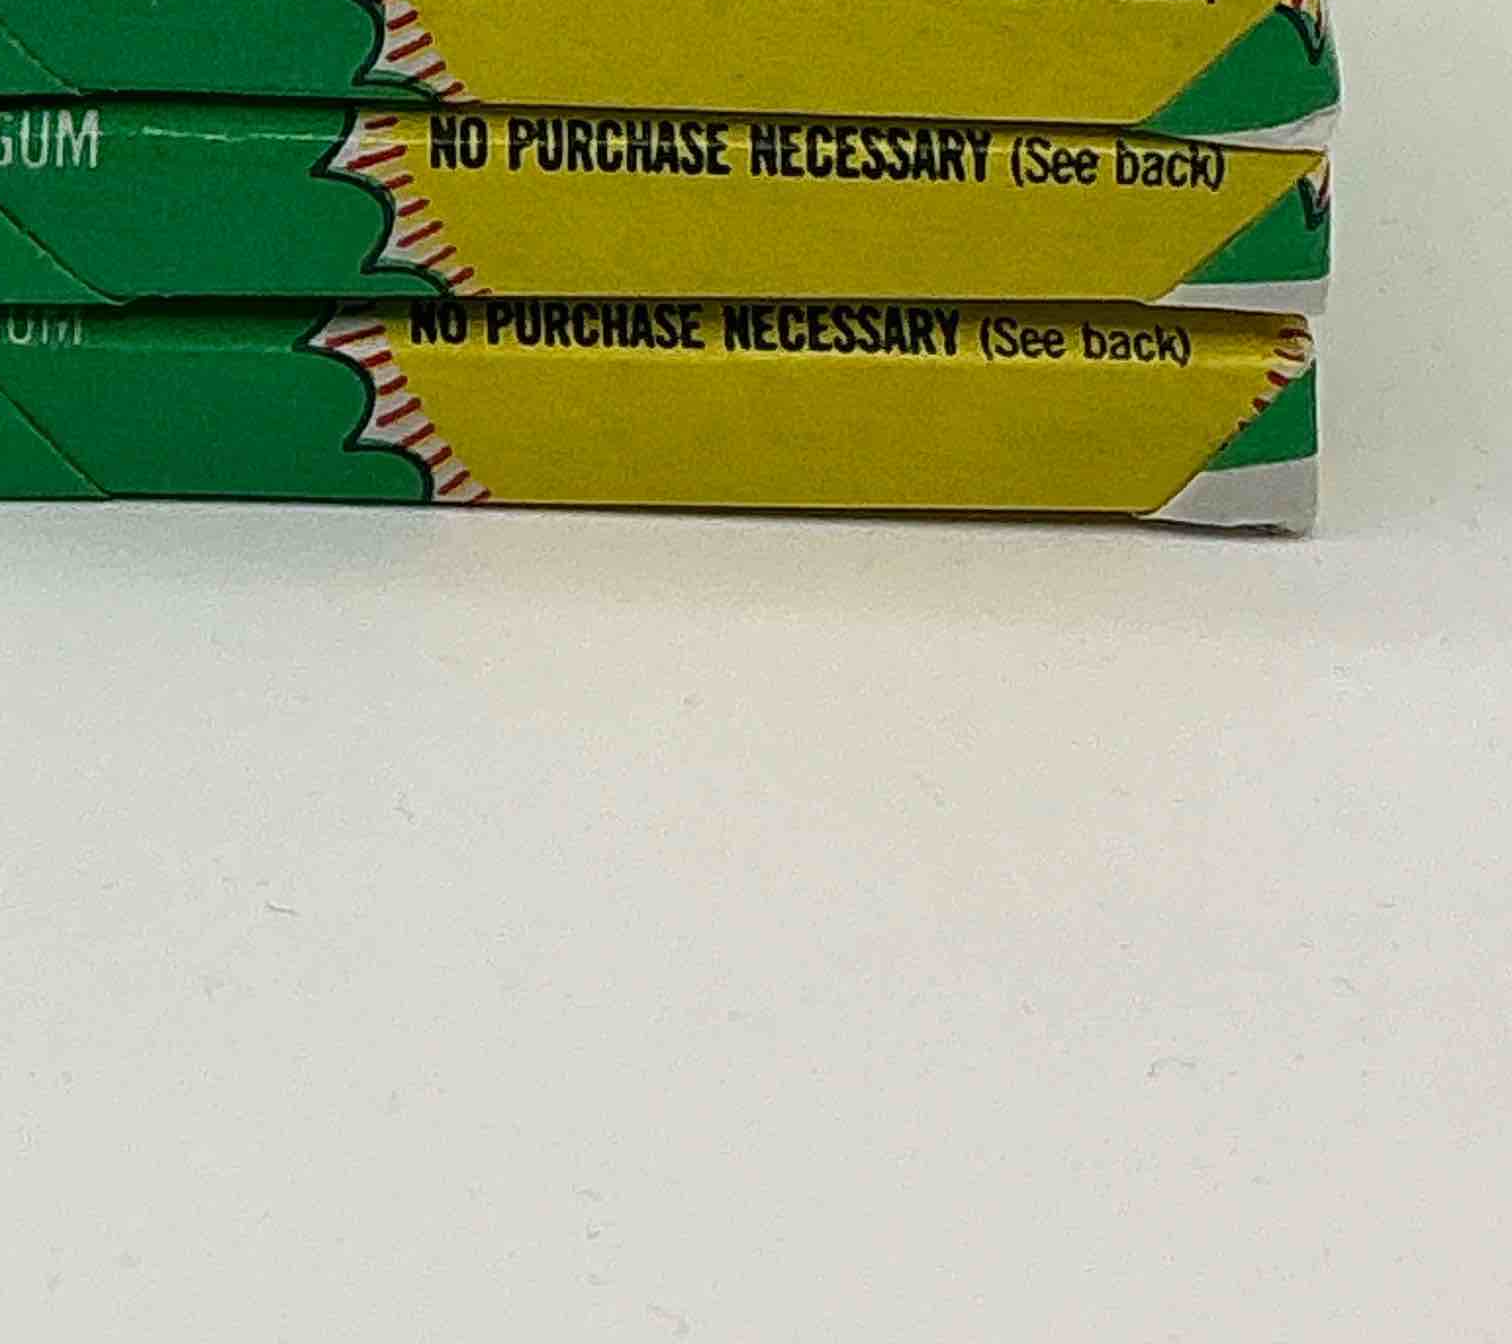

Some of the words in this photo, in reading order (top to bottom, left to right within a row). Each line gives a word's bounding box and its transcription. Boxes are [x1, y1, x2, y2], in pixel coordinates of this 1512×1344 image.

[428, 115, 488, 169] NO
[507, 118, 731, 175] PURCHASE
[748, 123, 991, 183] NECESSARY
[1009, 135, 1099, 188] (See
[1115, 134, 1226, 192] back)
[409, 301, 467, 346] NO
[486, 302, 705, 350] PURCHASE
[721, 304, 961, 356] NECESSARY
[980, 316, 1067, 361] (See
[1080, 320, 1191, 367] back)
